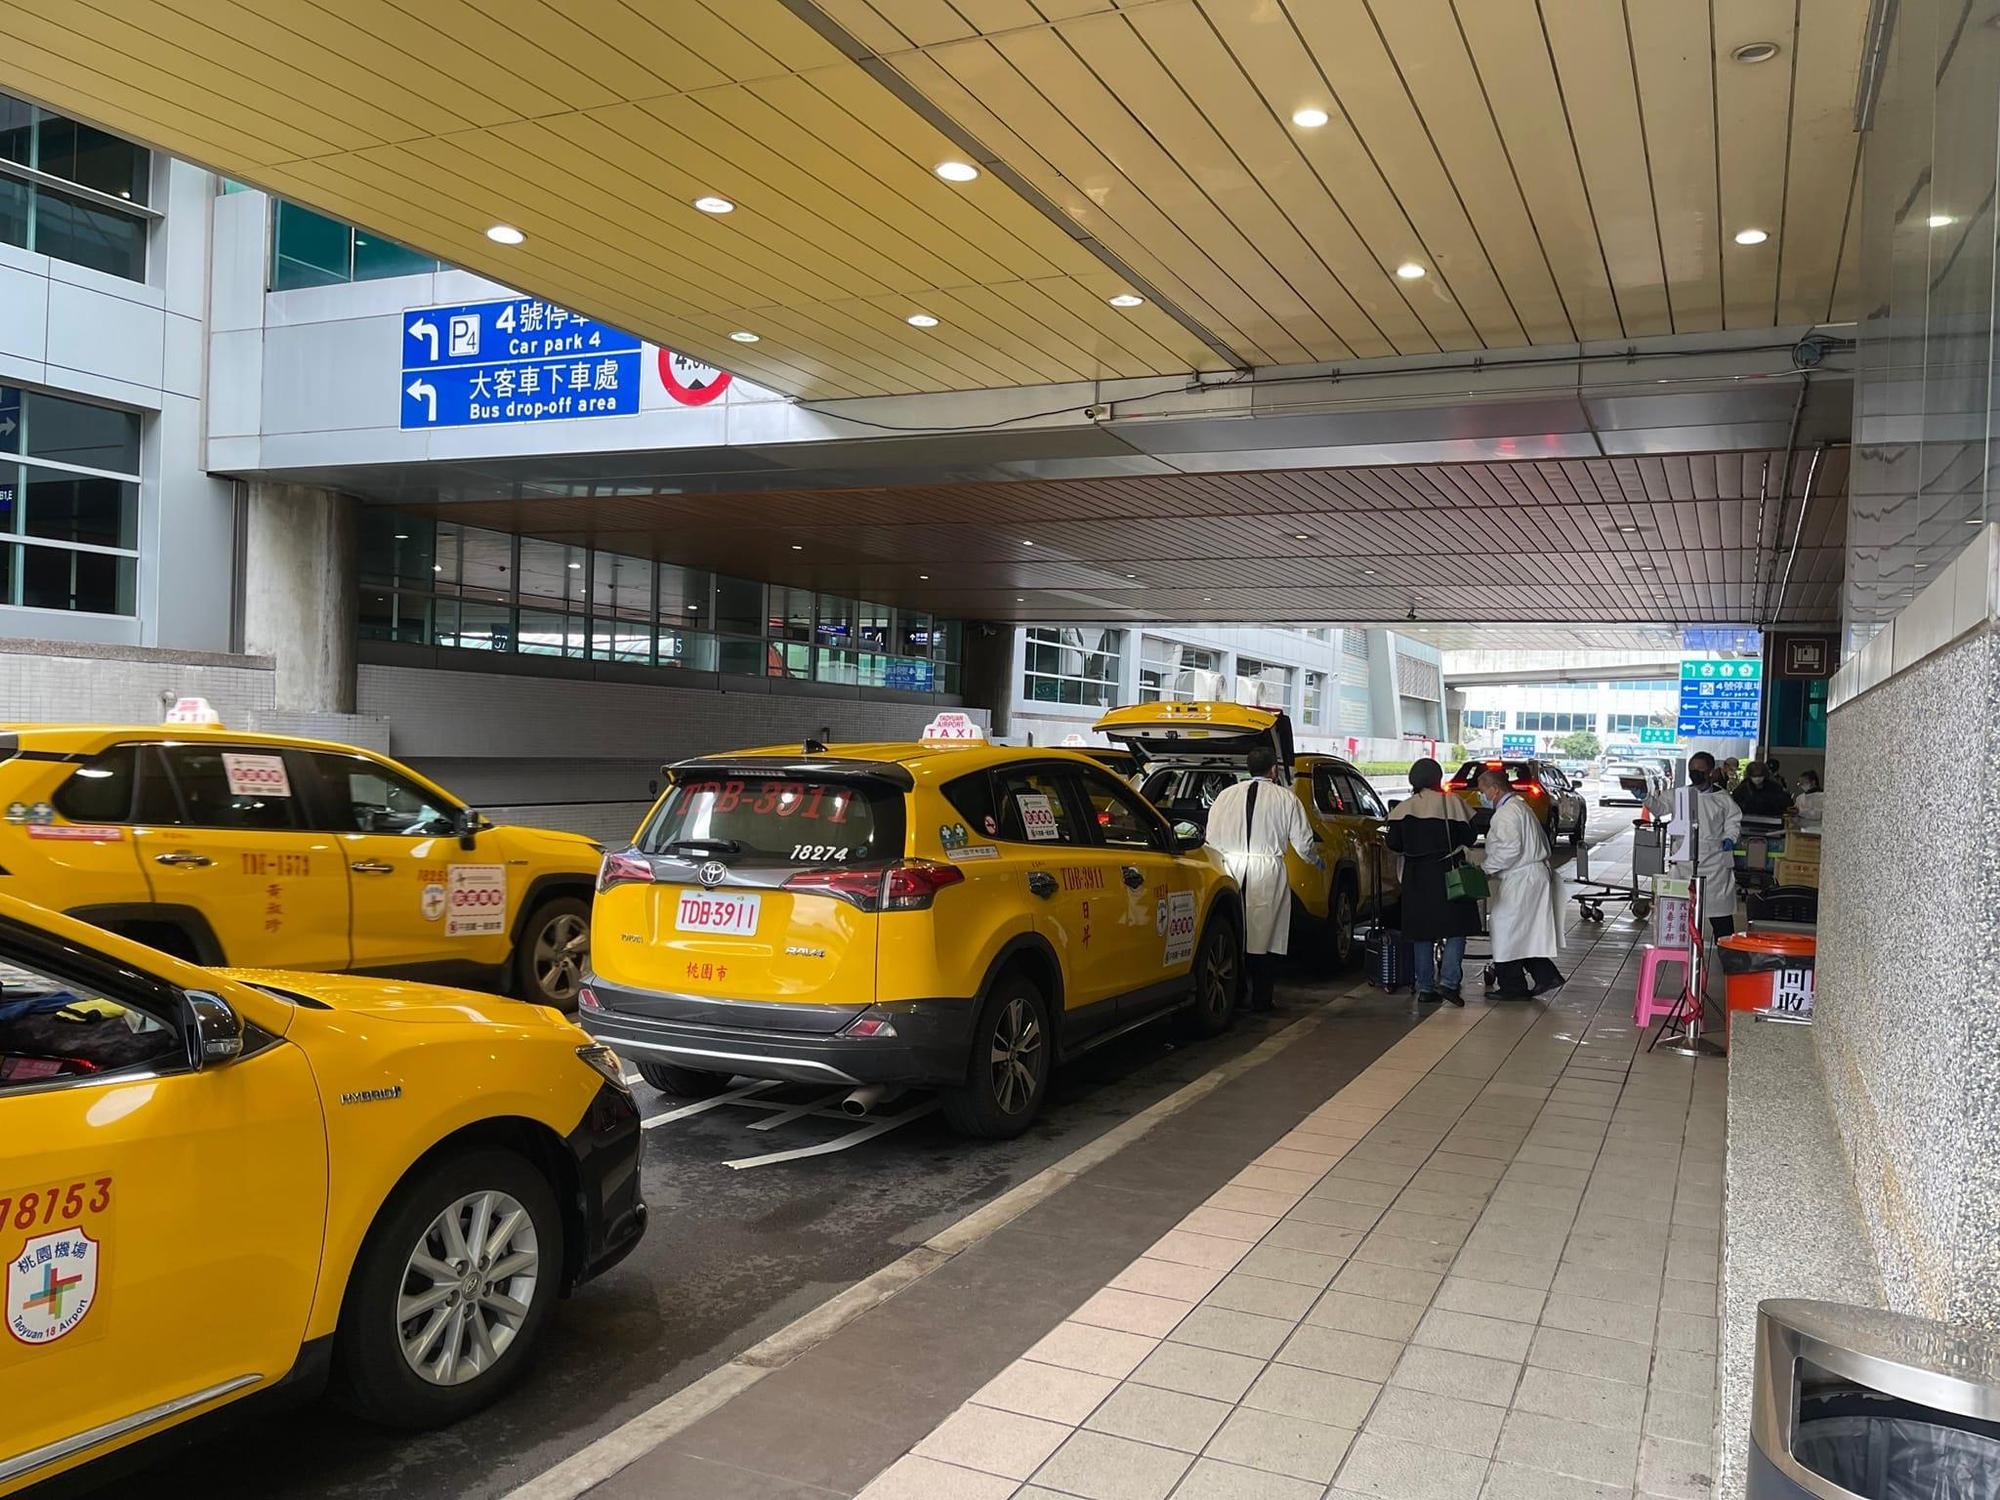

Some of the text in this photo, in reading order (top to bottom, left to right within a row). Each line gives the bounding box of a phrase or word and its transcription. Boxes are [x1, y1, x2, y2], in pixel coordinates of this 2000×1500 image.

[509, 331, 601, 356] Car park 4
[469, 359, 619, 400] 大客車下車處
[470, 397, 617, 420] Bus drop-off area
[928, 728, 973, 738] TAXI
[676, 780, 853, 824] TDB-3911
[790, 844, 849, 862] 18274
[687, 961, 728, 982] 桃園市
[1778, 967, 1805, 1011] 回收
[17, 1241, 88, 1274] 桃園機場
[13, 1299, 88, 1339] Taoyuan 18 Airport
